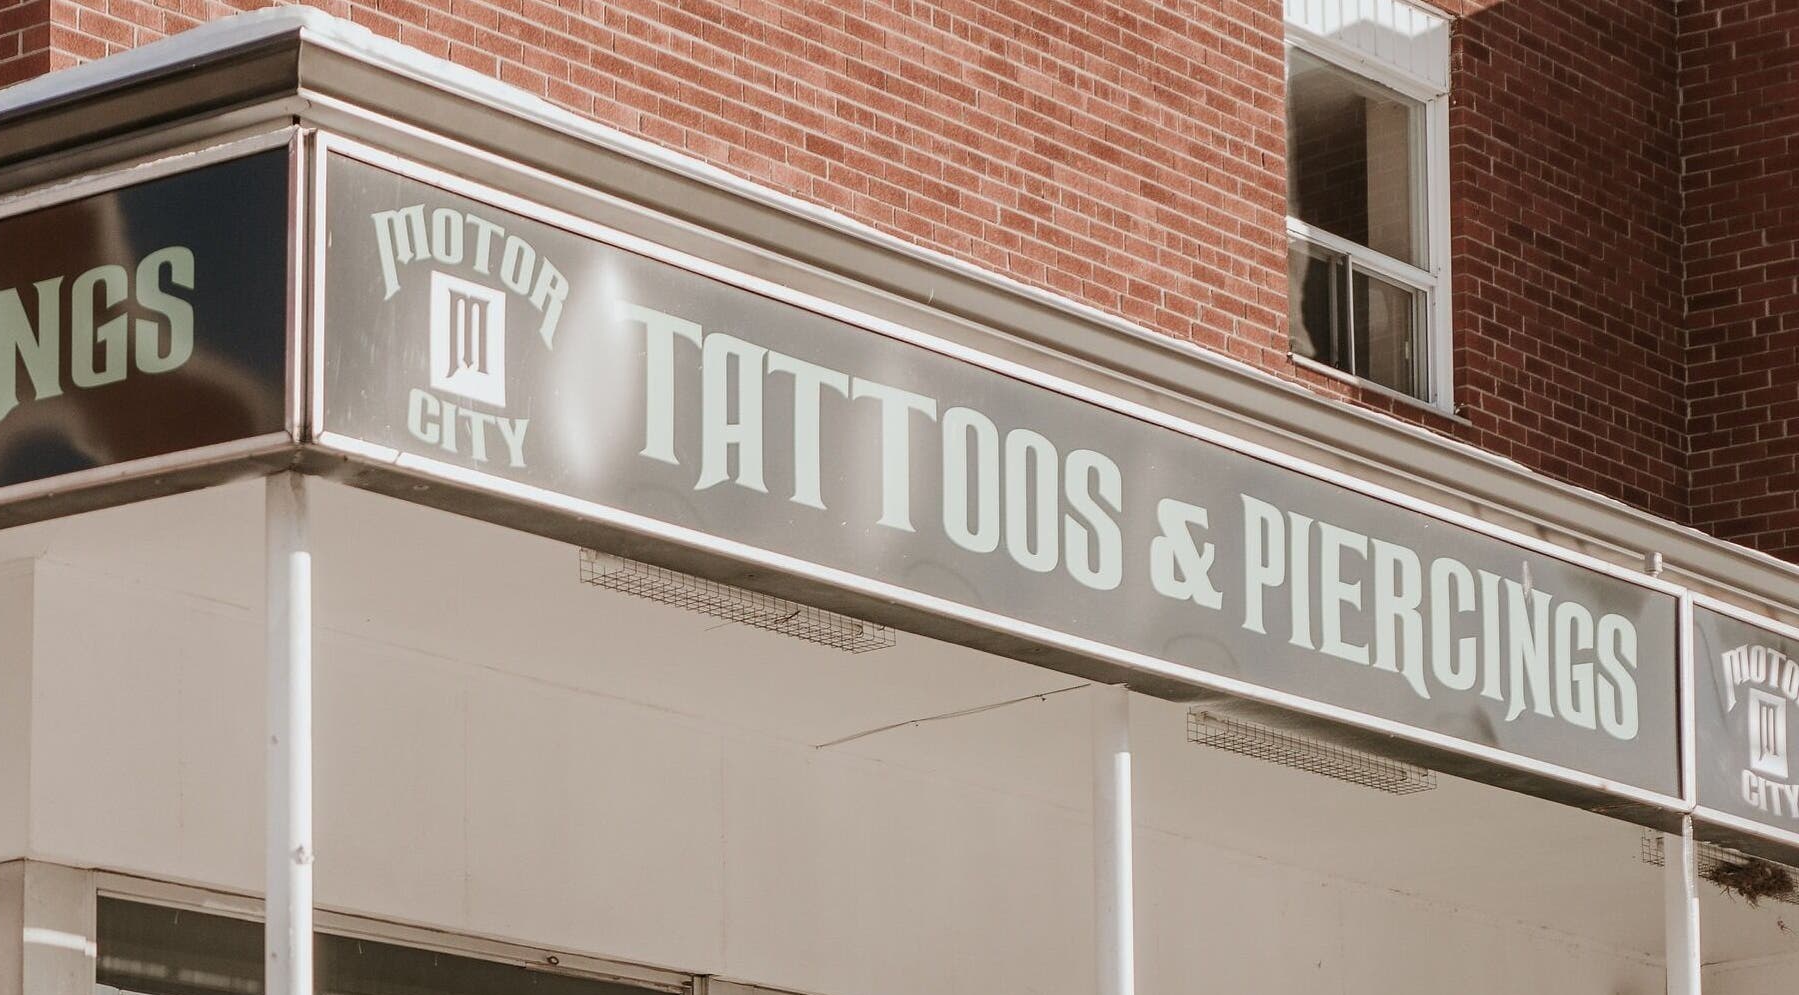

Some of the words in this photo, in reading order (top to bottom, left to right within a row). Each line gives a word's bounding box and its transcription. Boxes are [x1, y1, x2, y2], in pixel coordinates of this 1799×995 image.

[371, 203, 570, 350] MOTOR
[408, 387, 529, 468] CITY
[614, 299, 1123, 591] TATTOOS
[1150, 498, 1223, 610] &
[1240, 493, 1639, 741] PIERCINGS
[1722, 644, 1799, 712] MOTO
